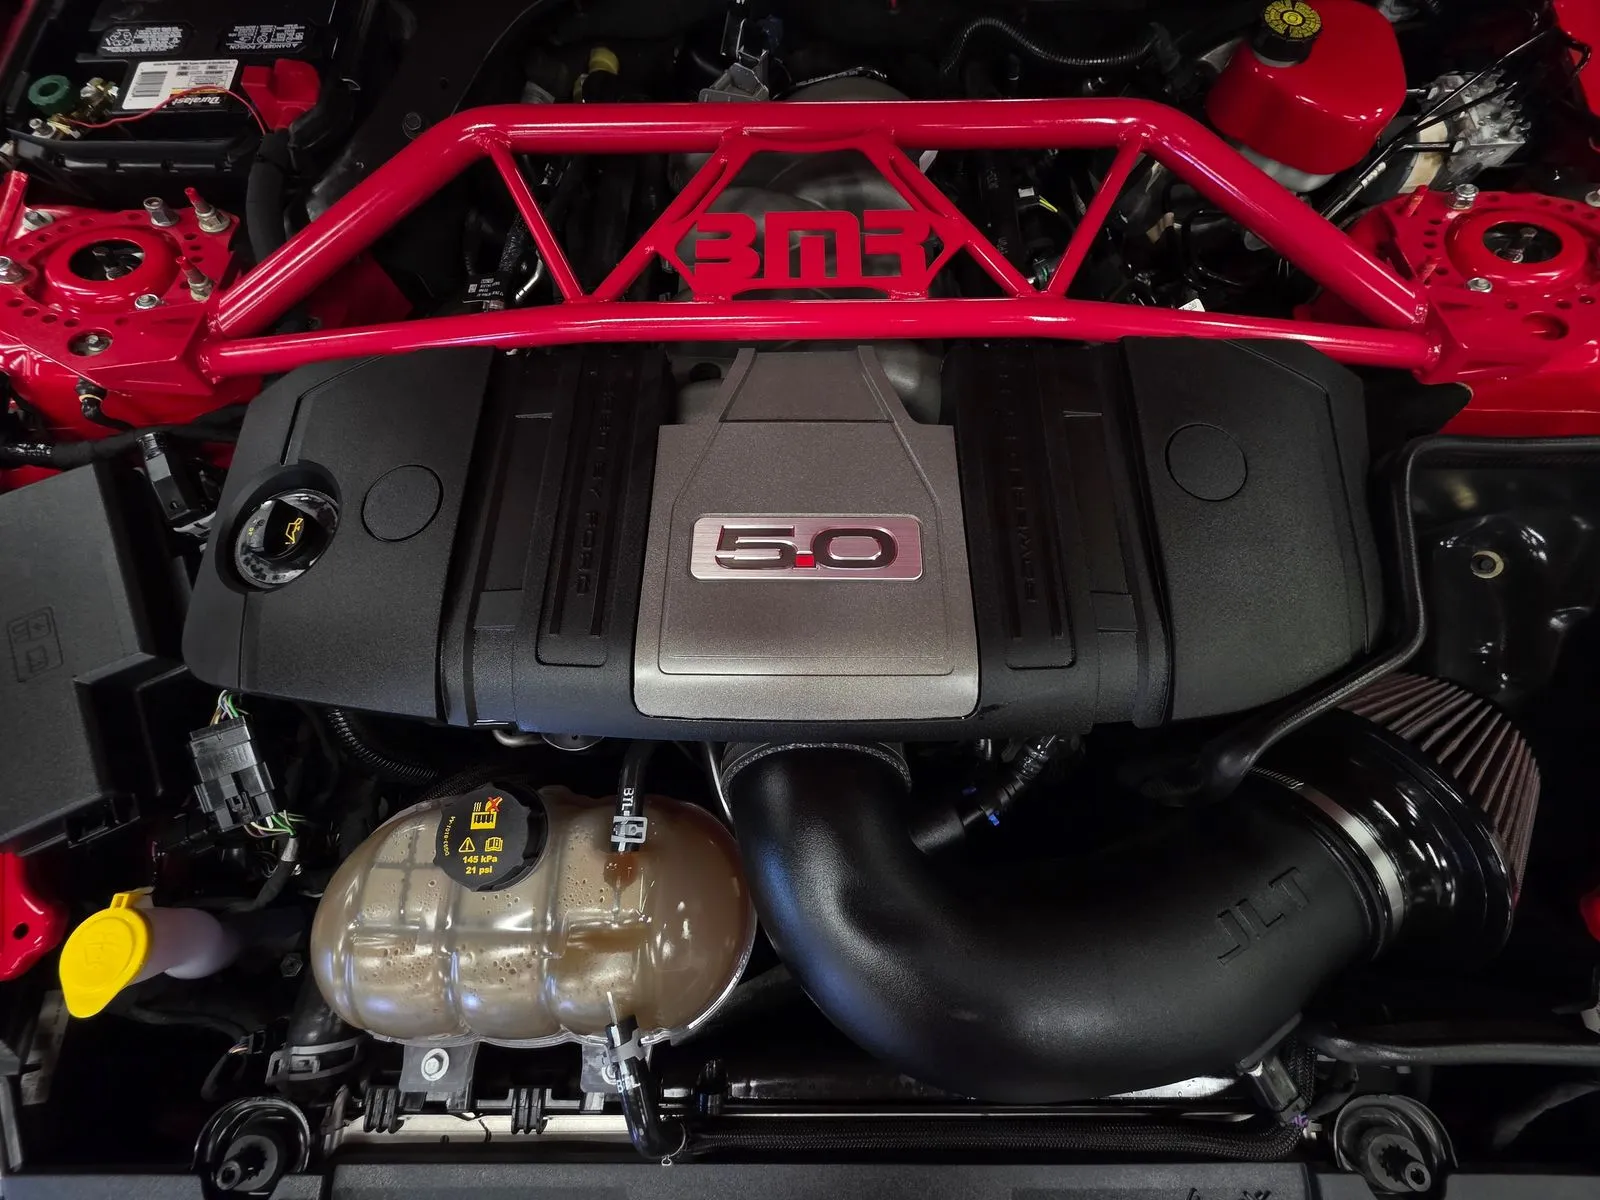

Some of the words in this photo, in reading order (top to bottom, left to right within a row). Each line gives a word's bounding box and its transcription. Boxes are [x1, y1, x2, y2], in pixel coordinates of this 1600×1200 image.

[171, 96, 221, 105] Duralast
[694, 210, 928, 293] BMR
[714, 524, 899, 570] 5.0
[463, 855, 478, 863] 145
[481, 855, 497, 863] kPa
[465, 866, 476, 874] 21
[479, 866, 493, 875] psi
[1217, 866, 1310, 965] JLT
